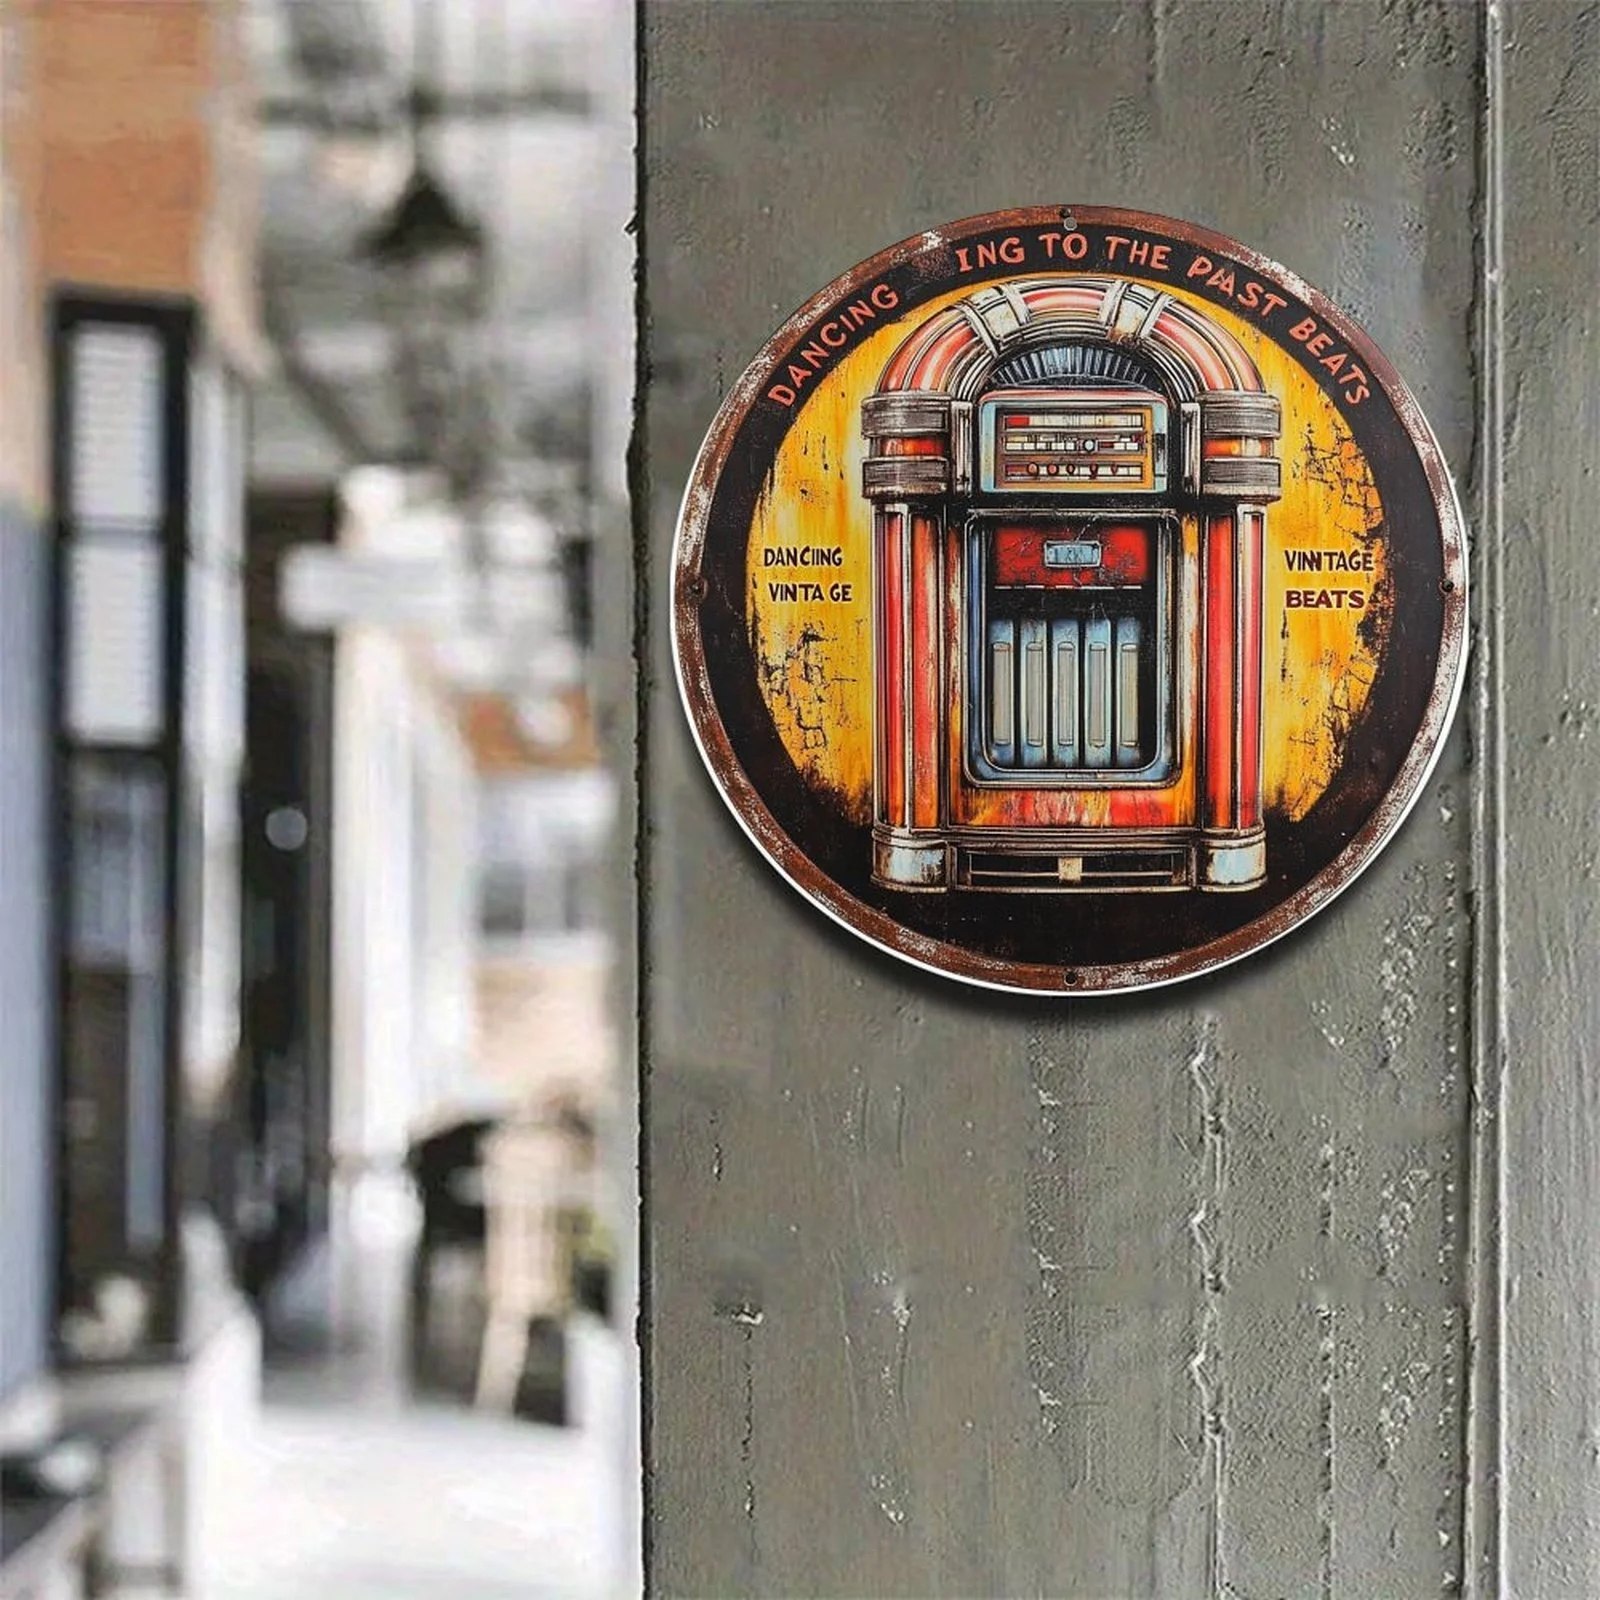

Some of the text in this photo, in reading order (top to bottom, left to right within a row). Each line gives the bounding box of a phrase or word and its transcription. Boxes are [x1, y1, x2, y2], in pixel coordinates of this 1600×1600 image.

[768, 284, 899, 407] DANCING
[955, 237, 1025, 272] ING
[1038, 233, 1088, 259] TO
[1105, 235, 1172, 270] THE
[1289, 317, 1370, 405] BEATS
[1285, 588, 1365, 609] BEATS
